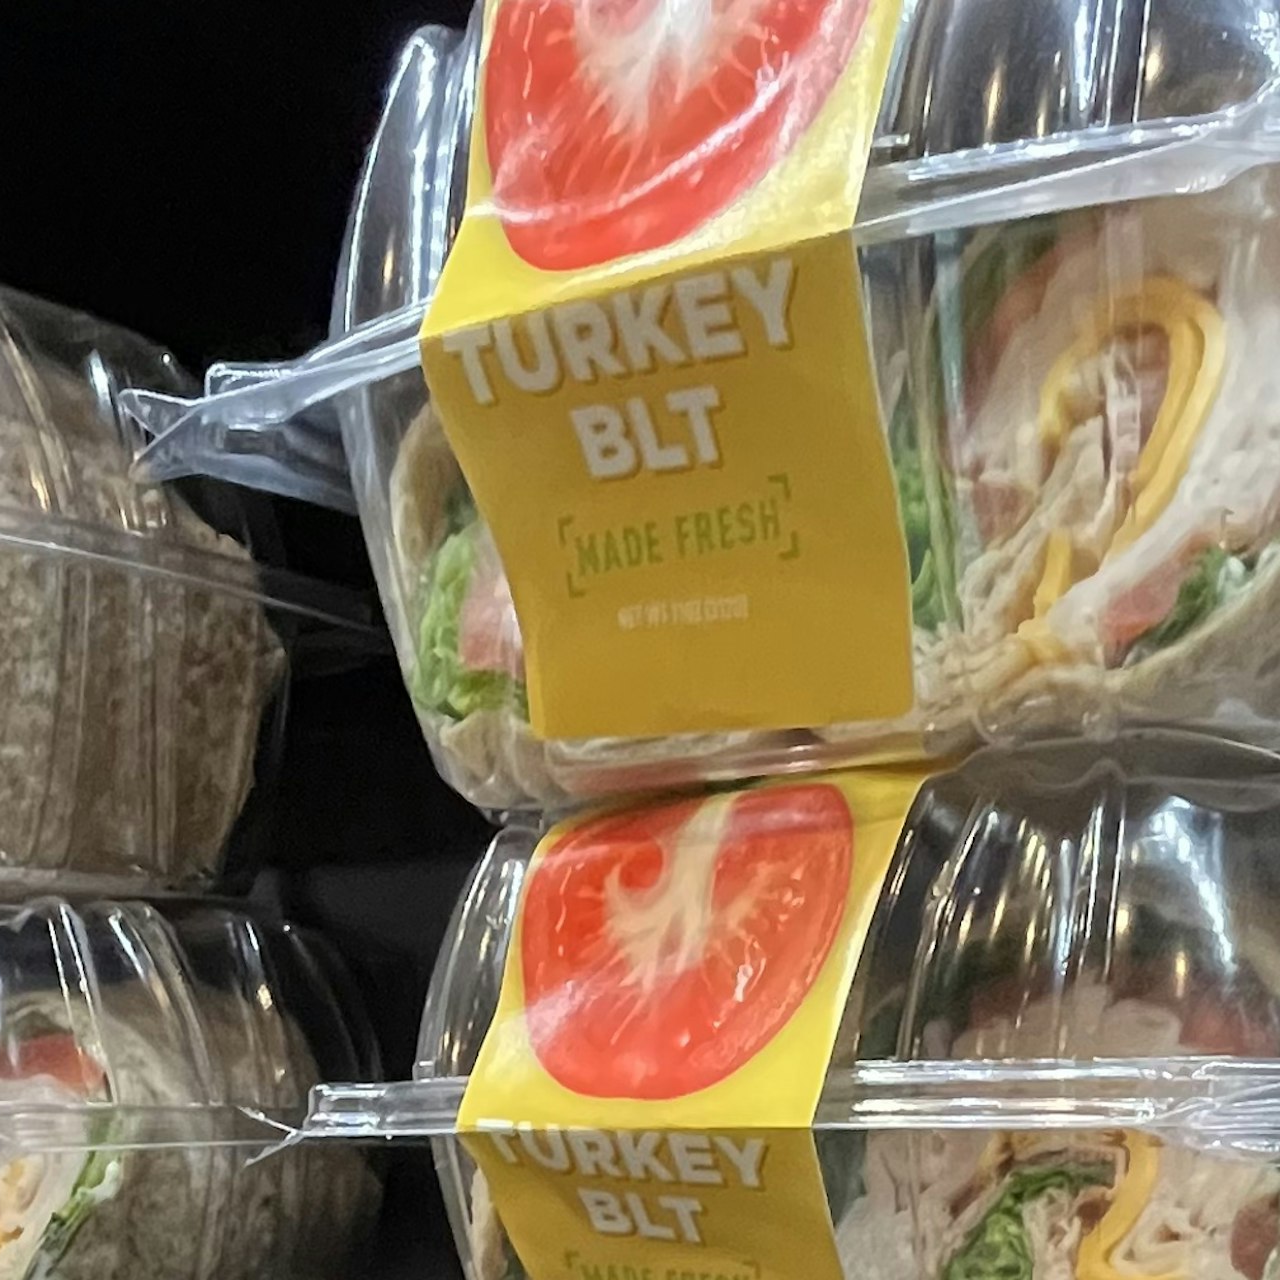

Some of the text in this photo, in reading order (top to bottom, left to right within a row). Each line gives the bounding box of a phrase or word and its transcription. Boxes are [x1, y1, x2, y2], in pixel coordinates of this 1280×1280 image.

[443, 256, 798, 407] TURKEY
[570, 385, 722, 481] BLT
[575, 497, 782, 579] MADE FRESH
[475, 1117, 768, 1188] TURKEY
[576, 1187, 703, 1244] BLT
